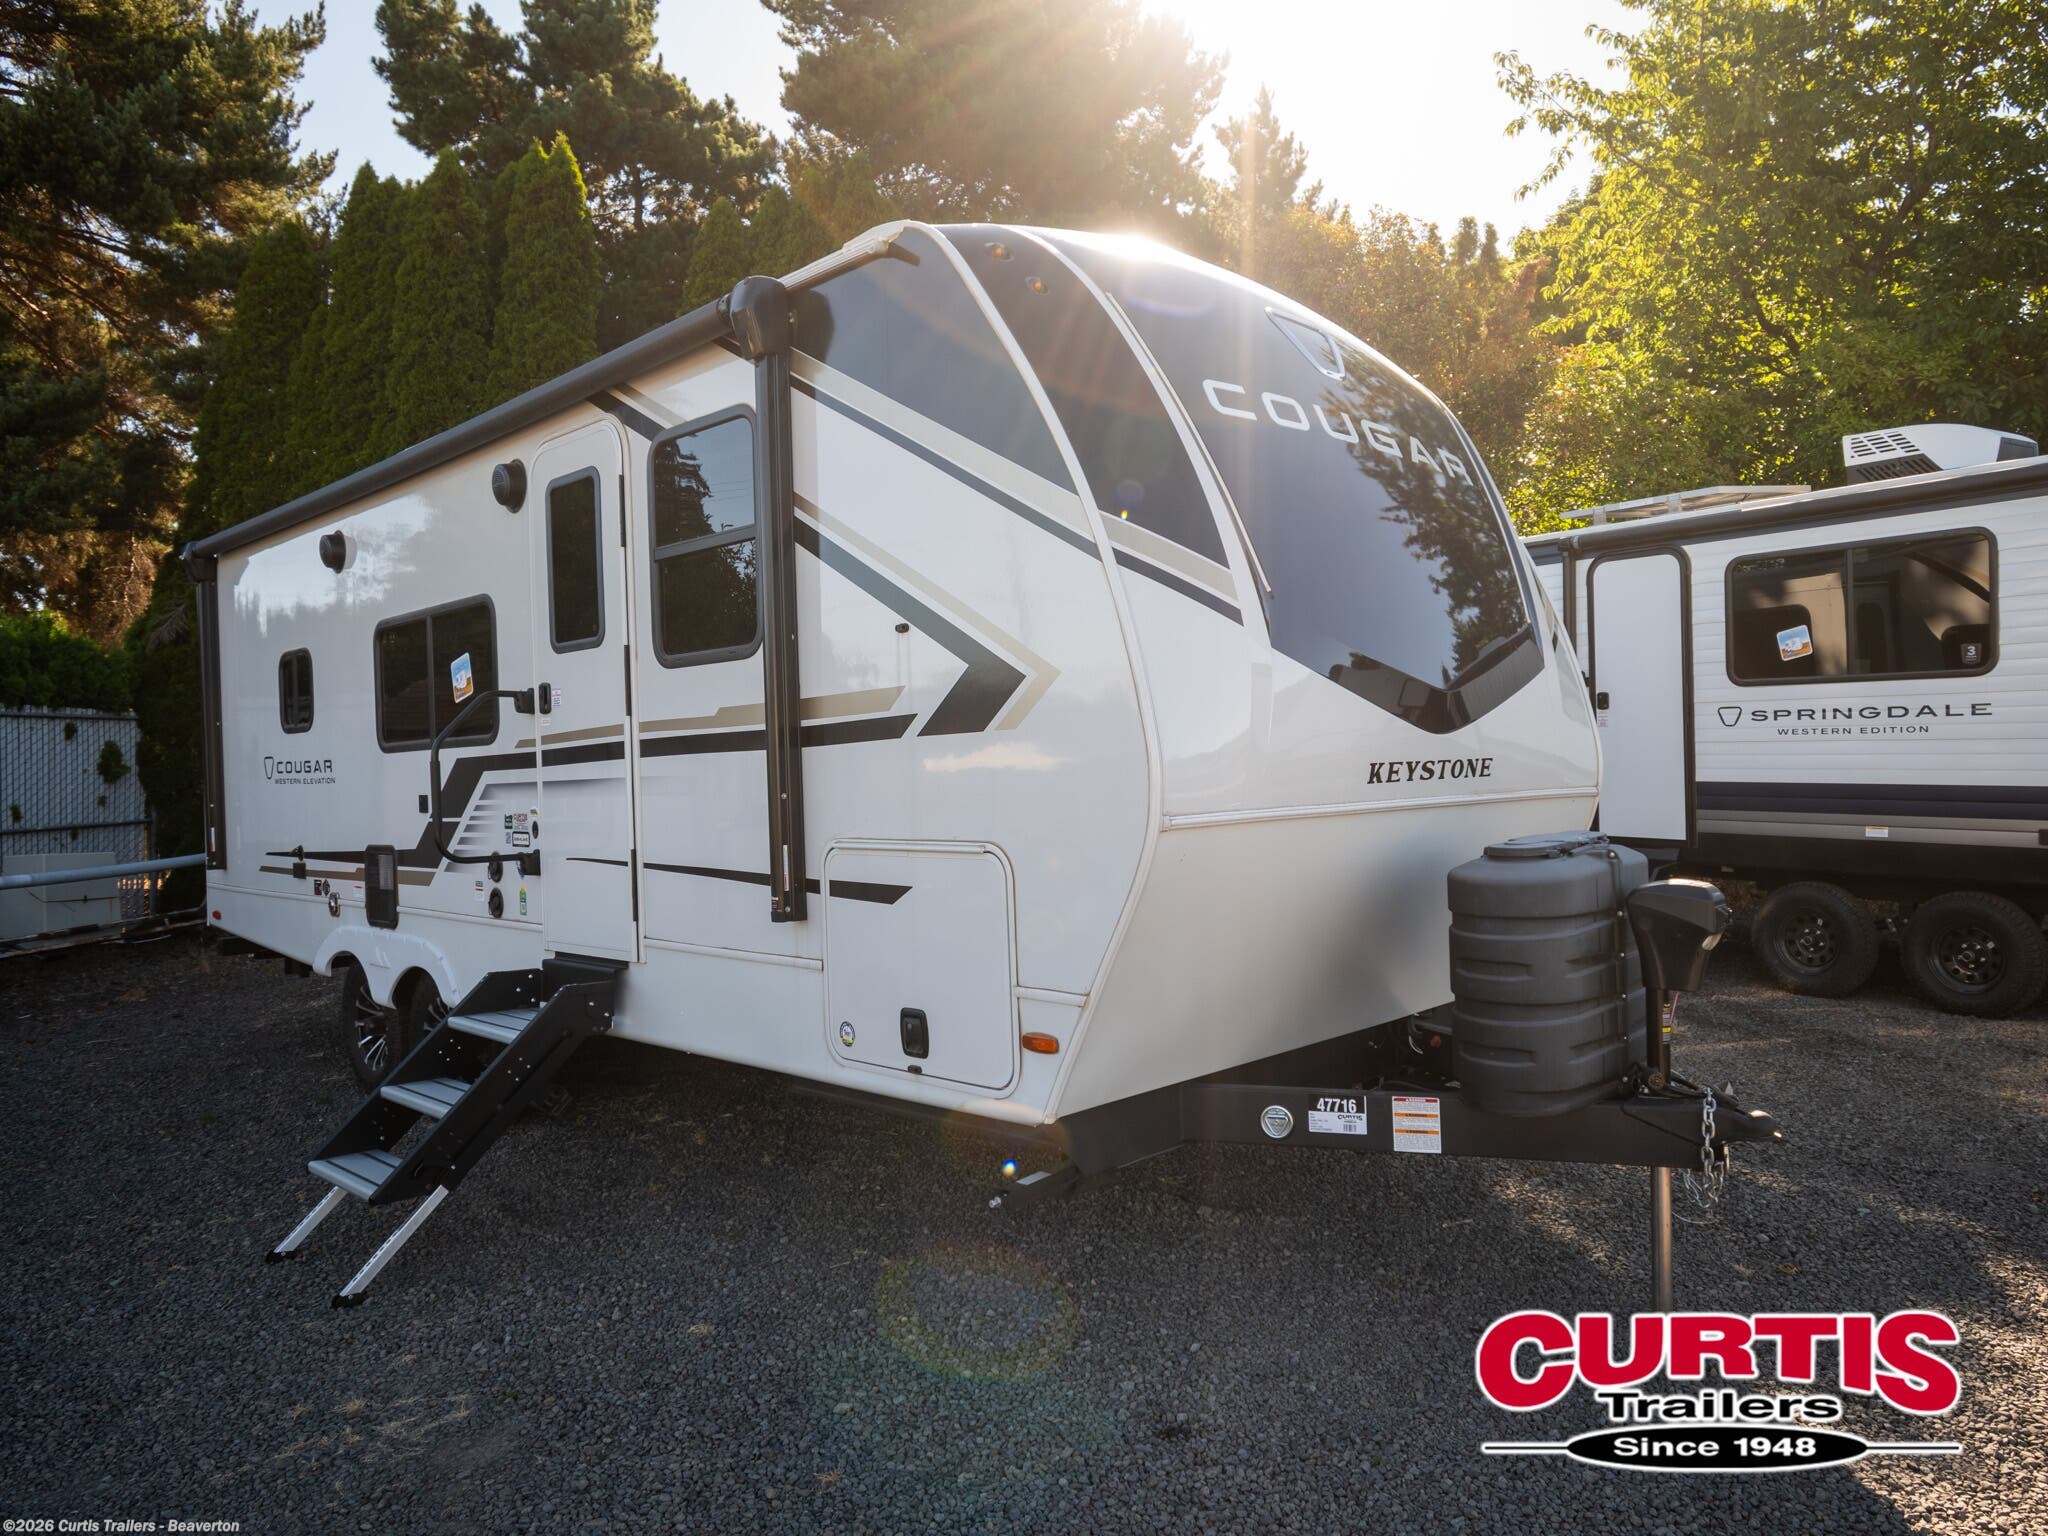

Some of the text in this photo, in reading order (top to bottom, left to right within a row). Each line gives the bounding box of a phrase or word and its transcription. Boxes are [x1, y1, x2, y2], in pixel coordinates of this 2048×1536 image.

[1203, 379, 1473, 487] COUGAR
[1750, 703, 1993, 722] SPRINGDALE
[1777, 725, 1930, 736] WESTERN EDITION
[276, 759, 333, 774] COUGAR
[1367, 758, 1493, 784] KEYSTONE
[303, 777, 336, 785] ELEVATION
[1316, 1097, 1357, 1113] 47716
